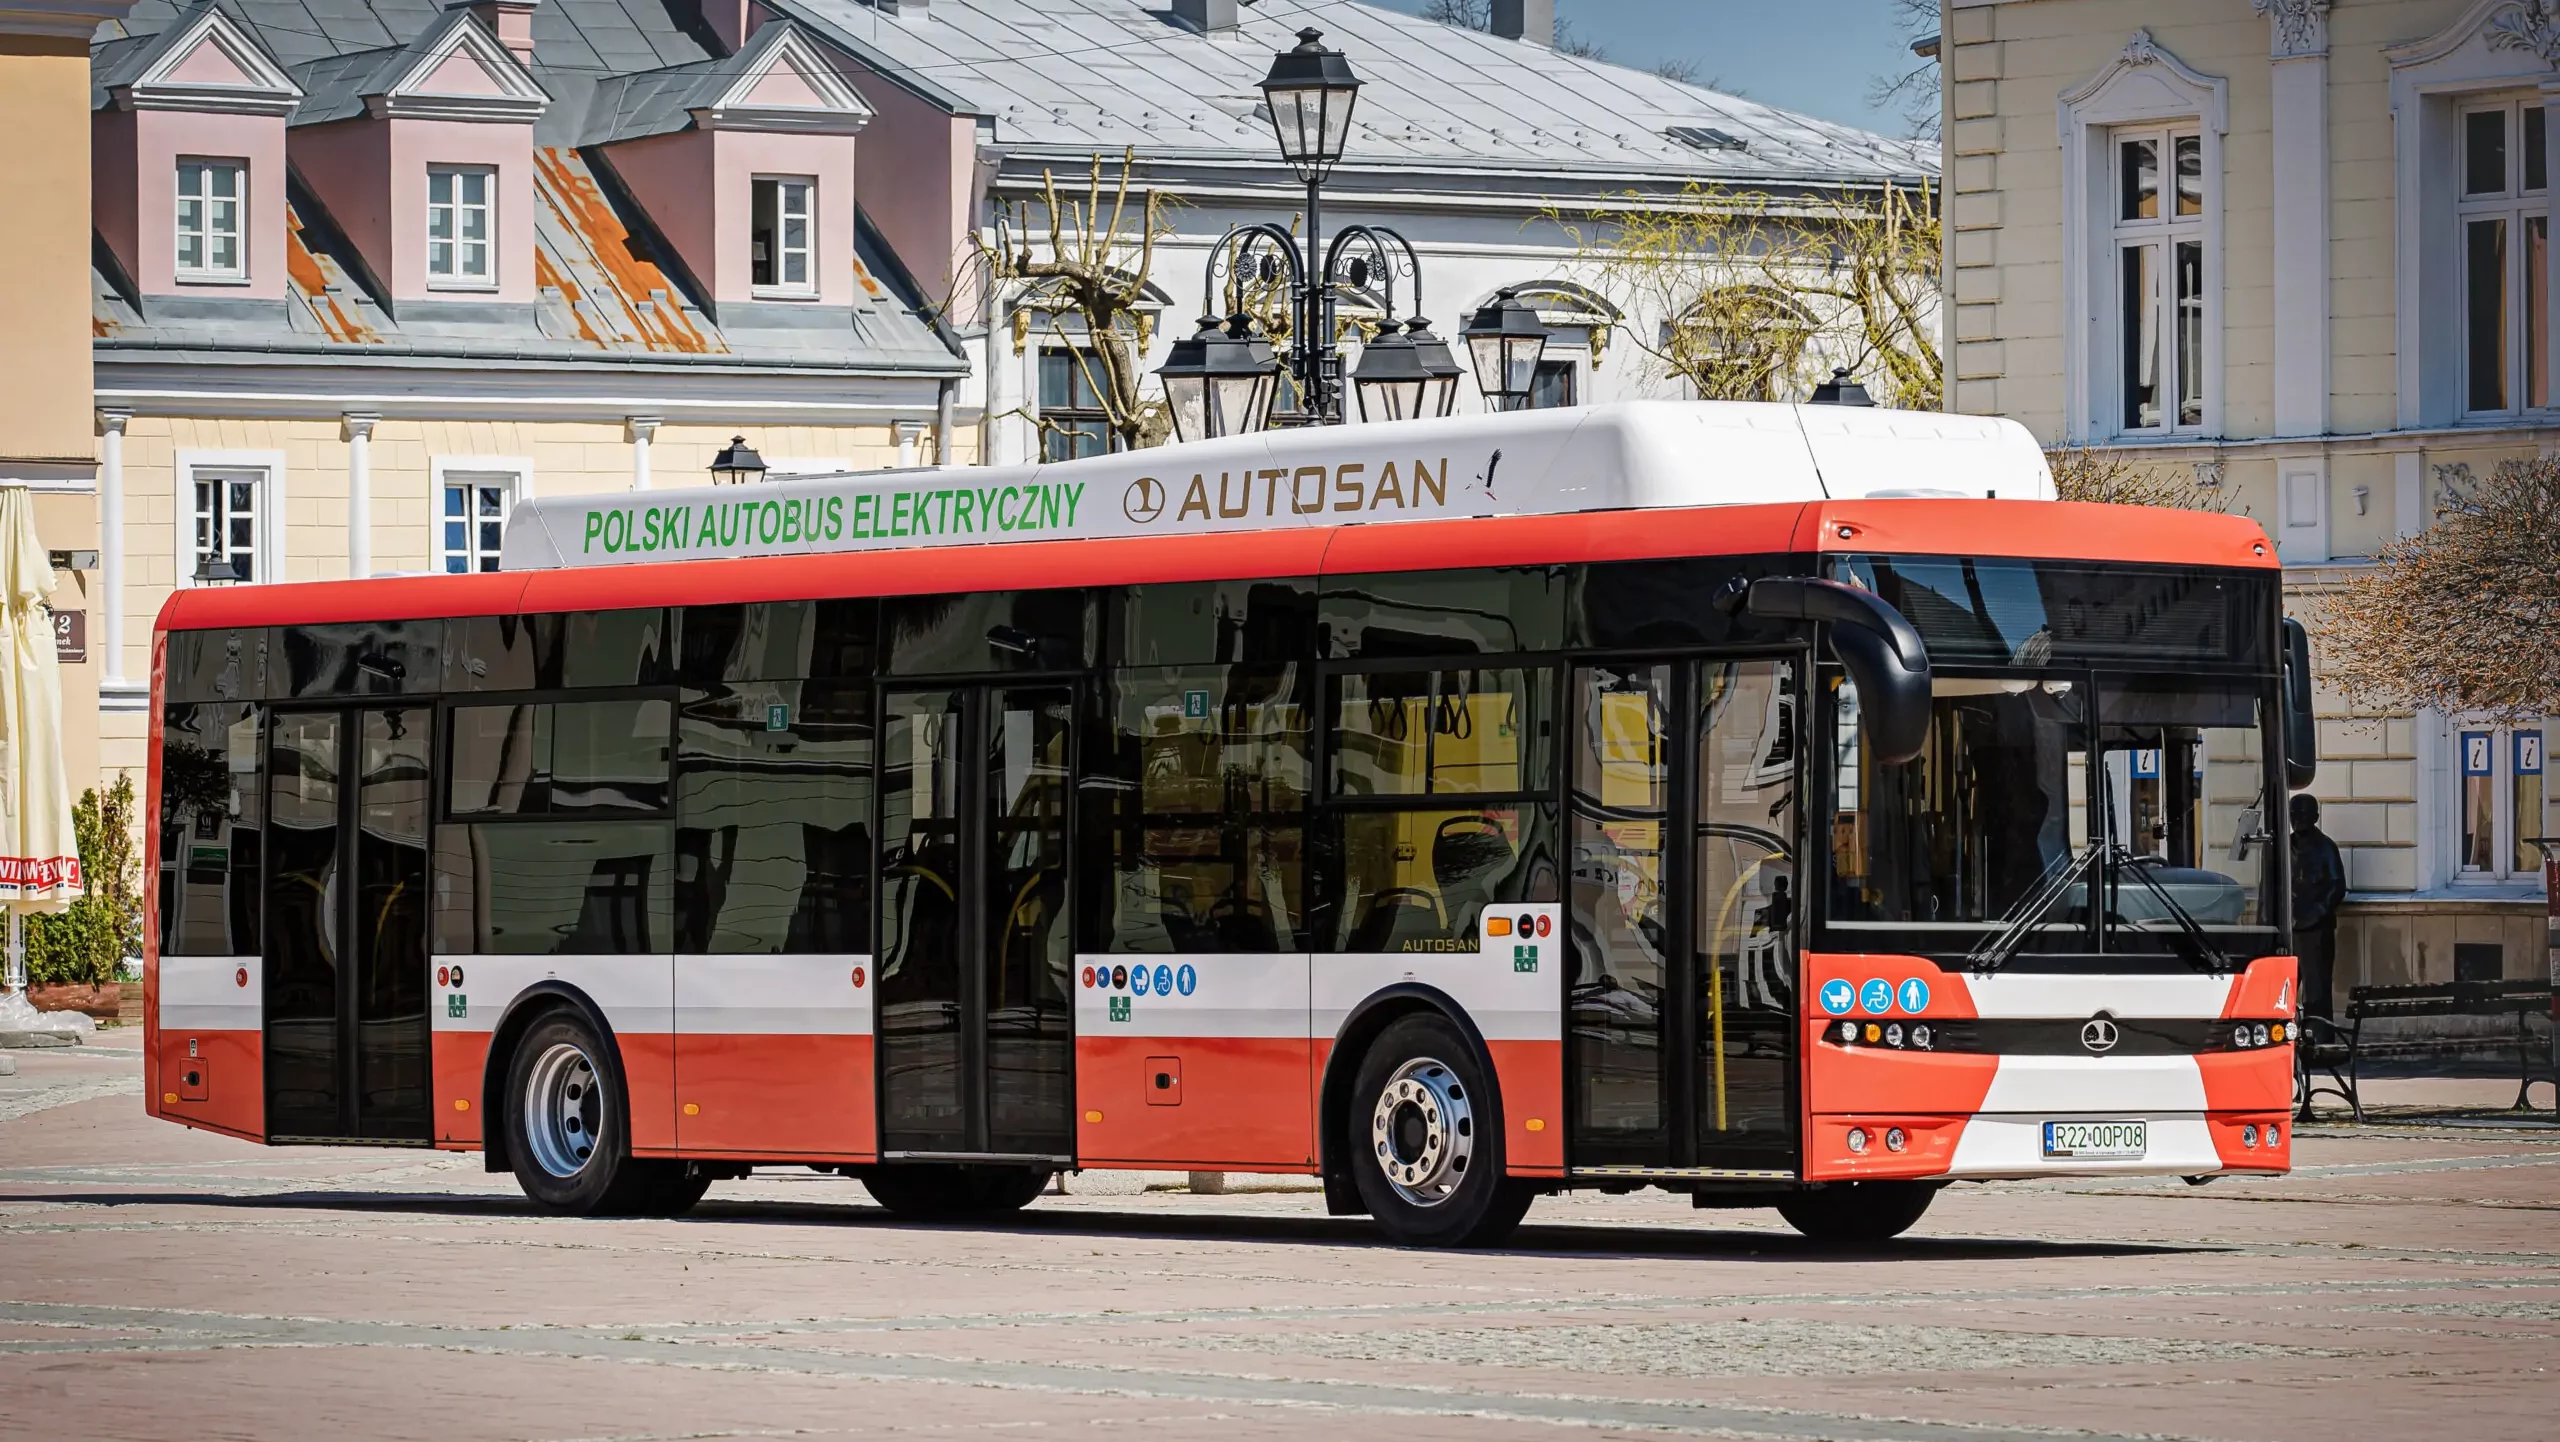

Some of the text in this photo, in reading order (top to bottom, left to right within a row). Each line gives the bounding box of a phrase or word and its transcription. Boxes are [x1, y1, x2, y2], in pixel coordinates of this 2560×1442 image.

[1177, 458, 1448, 522] AUTOSAN
[584, 482, 1085, 553] POLSKI AUTOBUS ELEKTRYCZNY
[2473, 739, 2482, 768] i
[2525, 739, 2535, 767] i
[1402, 939, 1479, 952] AUTOSAN
[2055, 1125, 2087, 1148] R22
